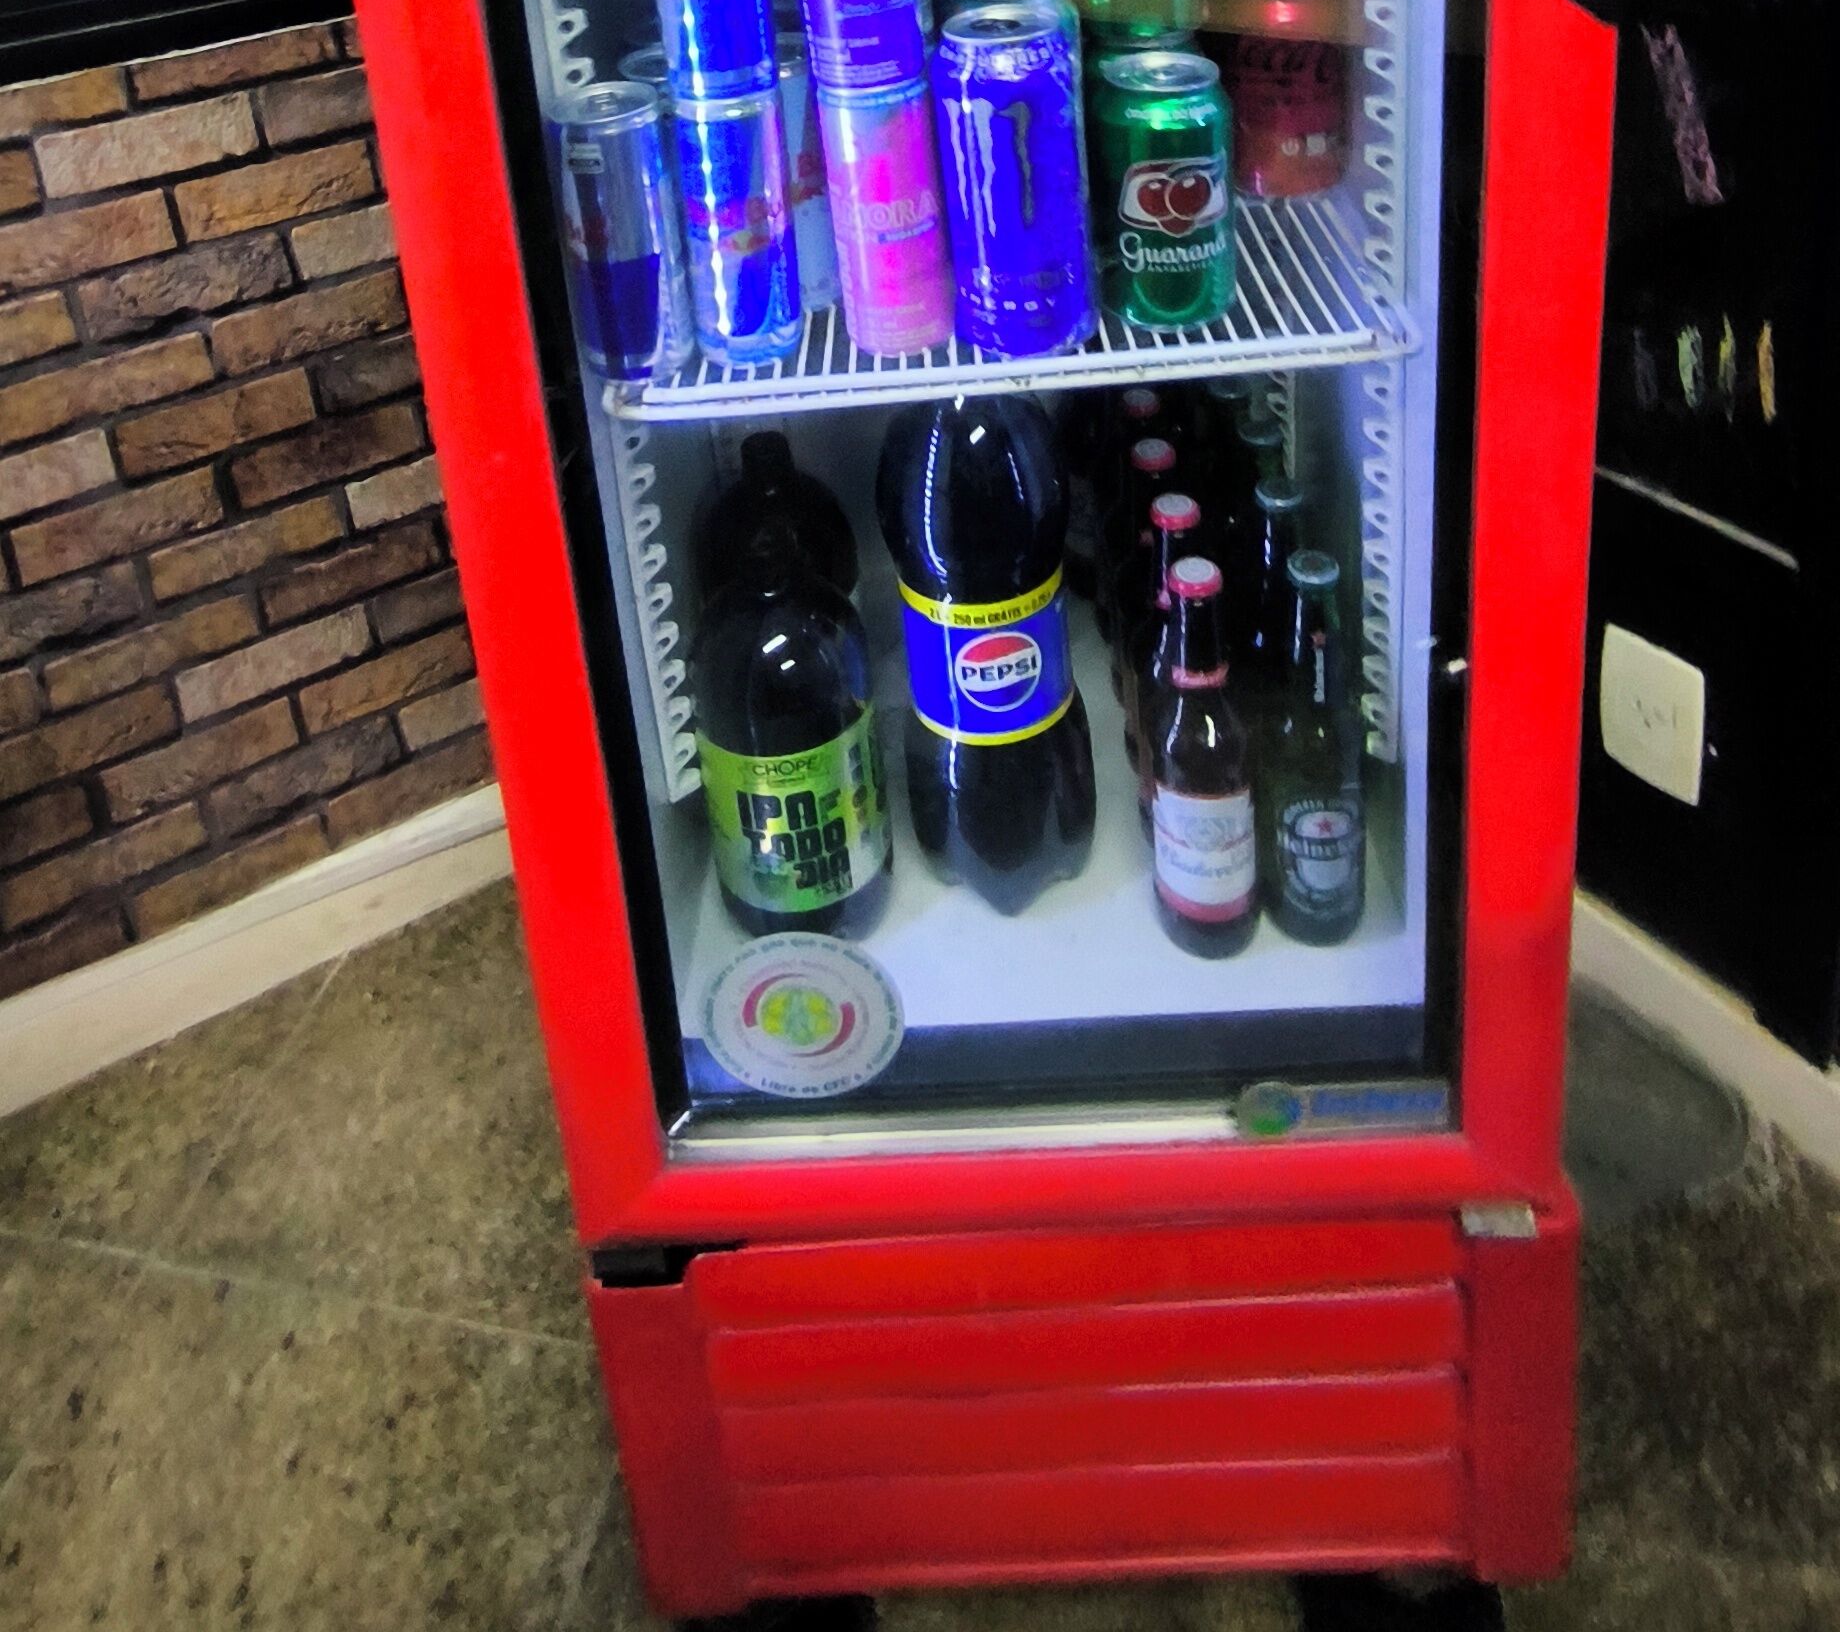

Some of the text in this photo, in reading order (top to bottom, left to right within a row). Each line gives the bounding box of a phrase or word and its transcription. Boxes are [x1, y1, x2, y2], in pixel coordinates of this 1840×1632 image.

[961, 654, 1038, 682] PEPSI
[736, 789, 818, 832] IPA
[742, 816, 847, 863] TODO
